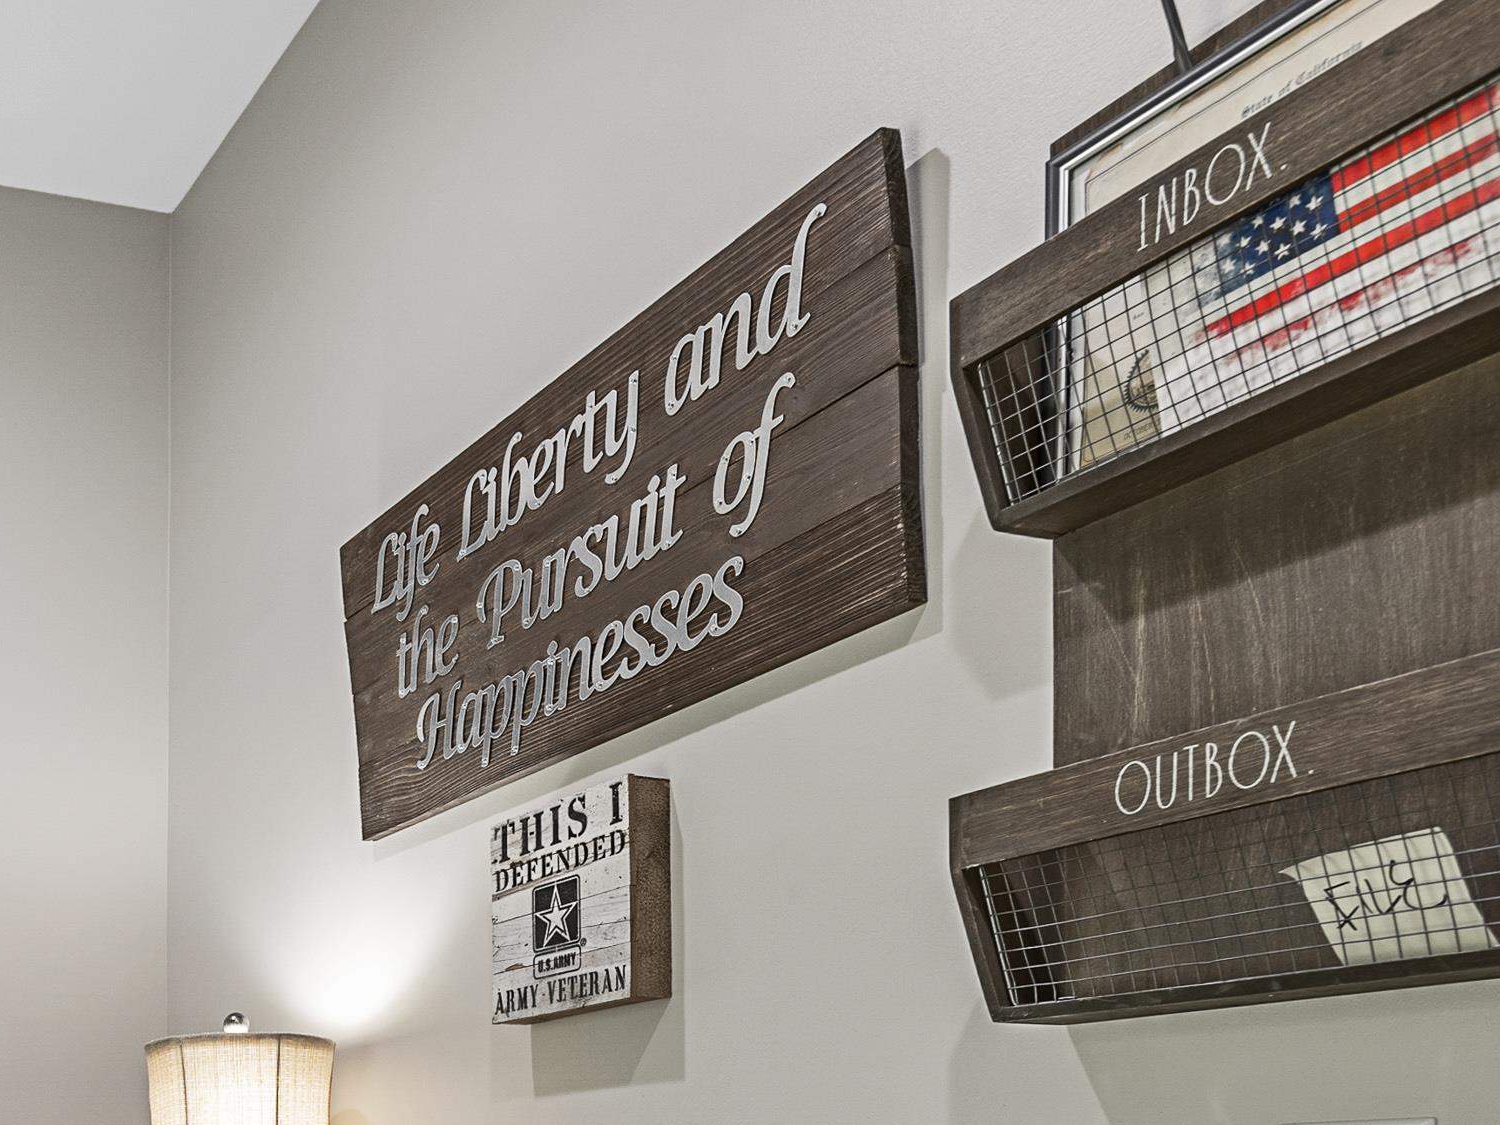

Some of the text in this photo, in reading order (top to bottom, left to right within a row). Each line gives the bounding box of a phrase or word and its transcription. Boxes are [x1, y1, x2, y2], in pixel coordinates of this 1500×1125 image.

[371, 202, 828, 622] Life Liberty and
[397, 372, 796, 698] the Pursuit of
[416, 555, 745, 770] Happinesses
[495, 782, 623, 863] THIS I
[495, 829, 628, 893] DEFENDED
[495, 965, 627, 1015] ARMY VETERAN
